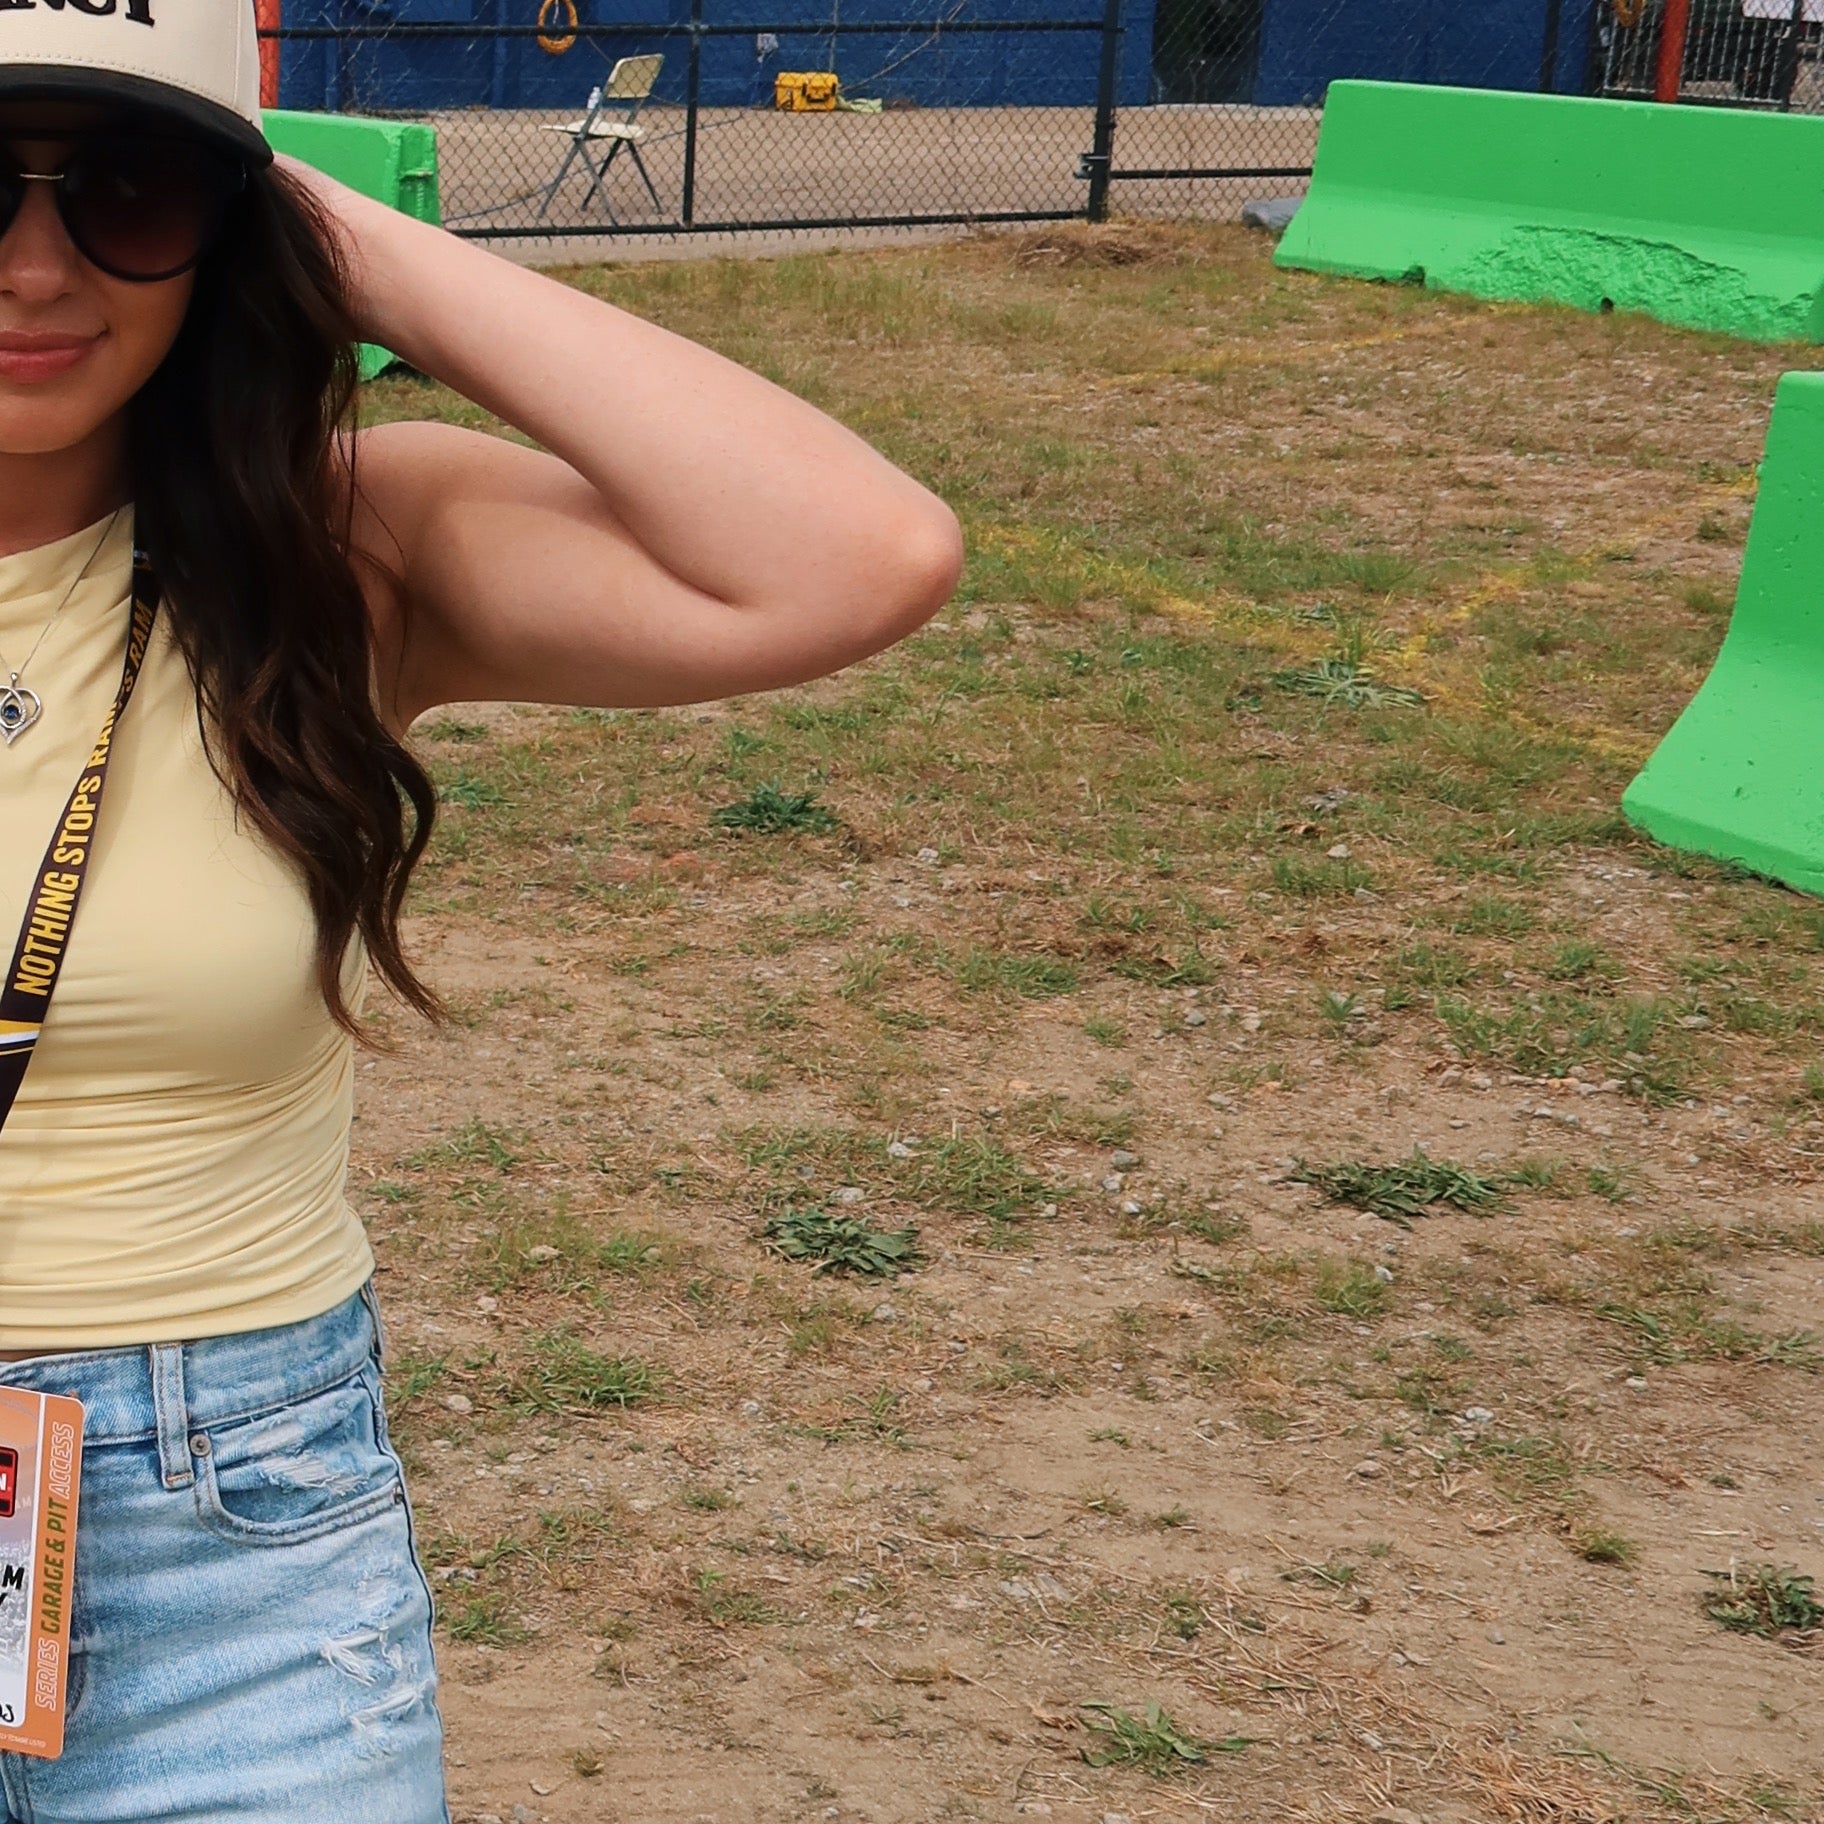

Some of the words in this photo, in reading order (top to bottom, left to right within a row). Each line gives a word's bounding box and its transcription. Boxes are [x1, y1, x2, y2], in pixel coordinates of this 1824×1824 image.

[128, 601, 154, 668] RAM
[13, 871, 80, 997] NOTHING
[53, 775, 102, 867] STOPS
[49, 1421, 74, 1500] ACCESS
[45, 1538, 65, 1554] &
[47, 1497, 68, 1533] PIT
[40, 1555, 64, 1634] GARAGE
[35, 1637, 60, 1712] SERIES
